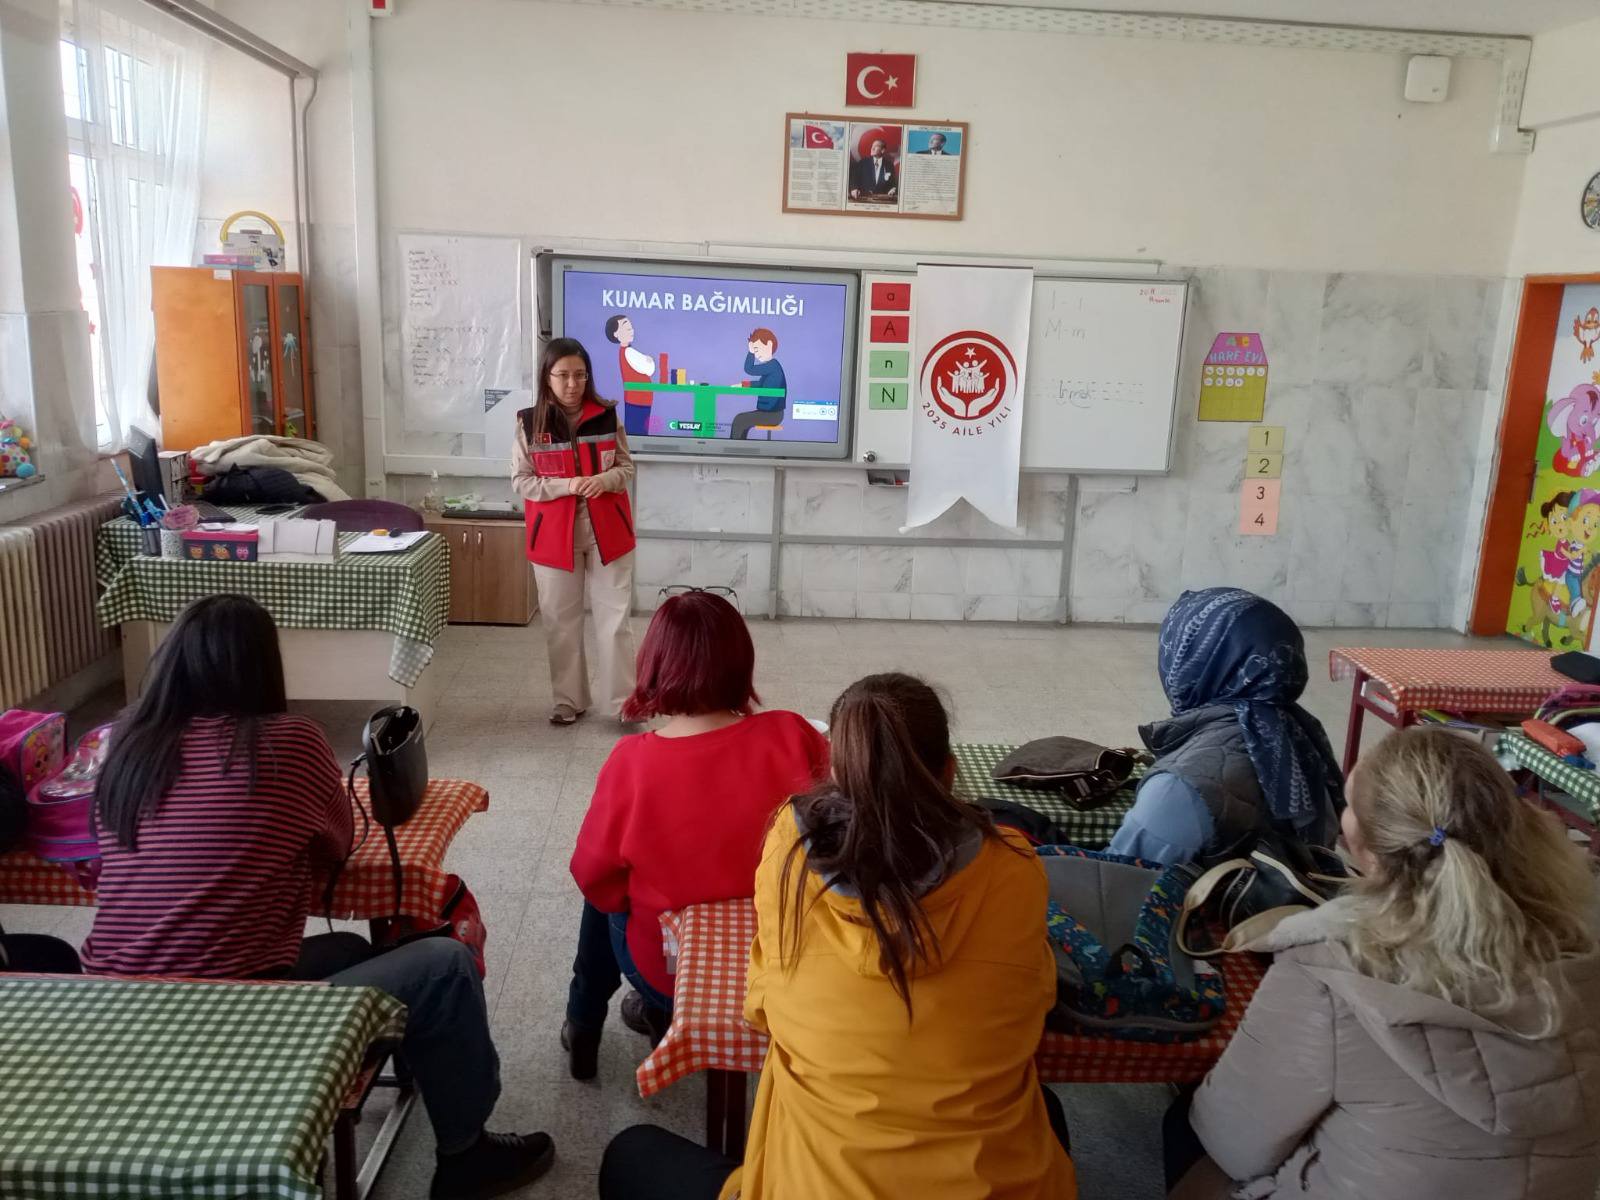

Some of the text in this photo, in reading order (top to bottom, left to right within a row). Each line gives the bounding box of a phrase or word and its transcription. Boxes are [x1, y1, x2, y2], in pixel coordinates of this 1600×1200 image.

[602, 289, 804, 317] KUMAR BAĞIMLILIĞI
[886, 292, 896, 302] a
[883, 320, 896, 336] A
[884, 359, 894, 369] n
[881, 386, 896, 403] N
[922, 402, 947, 430] 2025
[988, 406, 1012, 428] YILI
[1264, 430, 1270, 446] 1
[1258, 458, 1270, 474] 2
[1256, 486, 1265, 500] 3
[1254, 512, 1265, 527] 4
